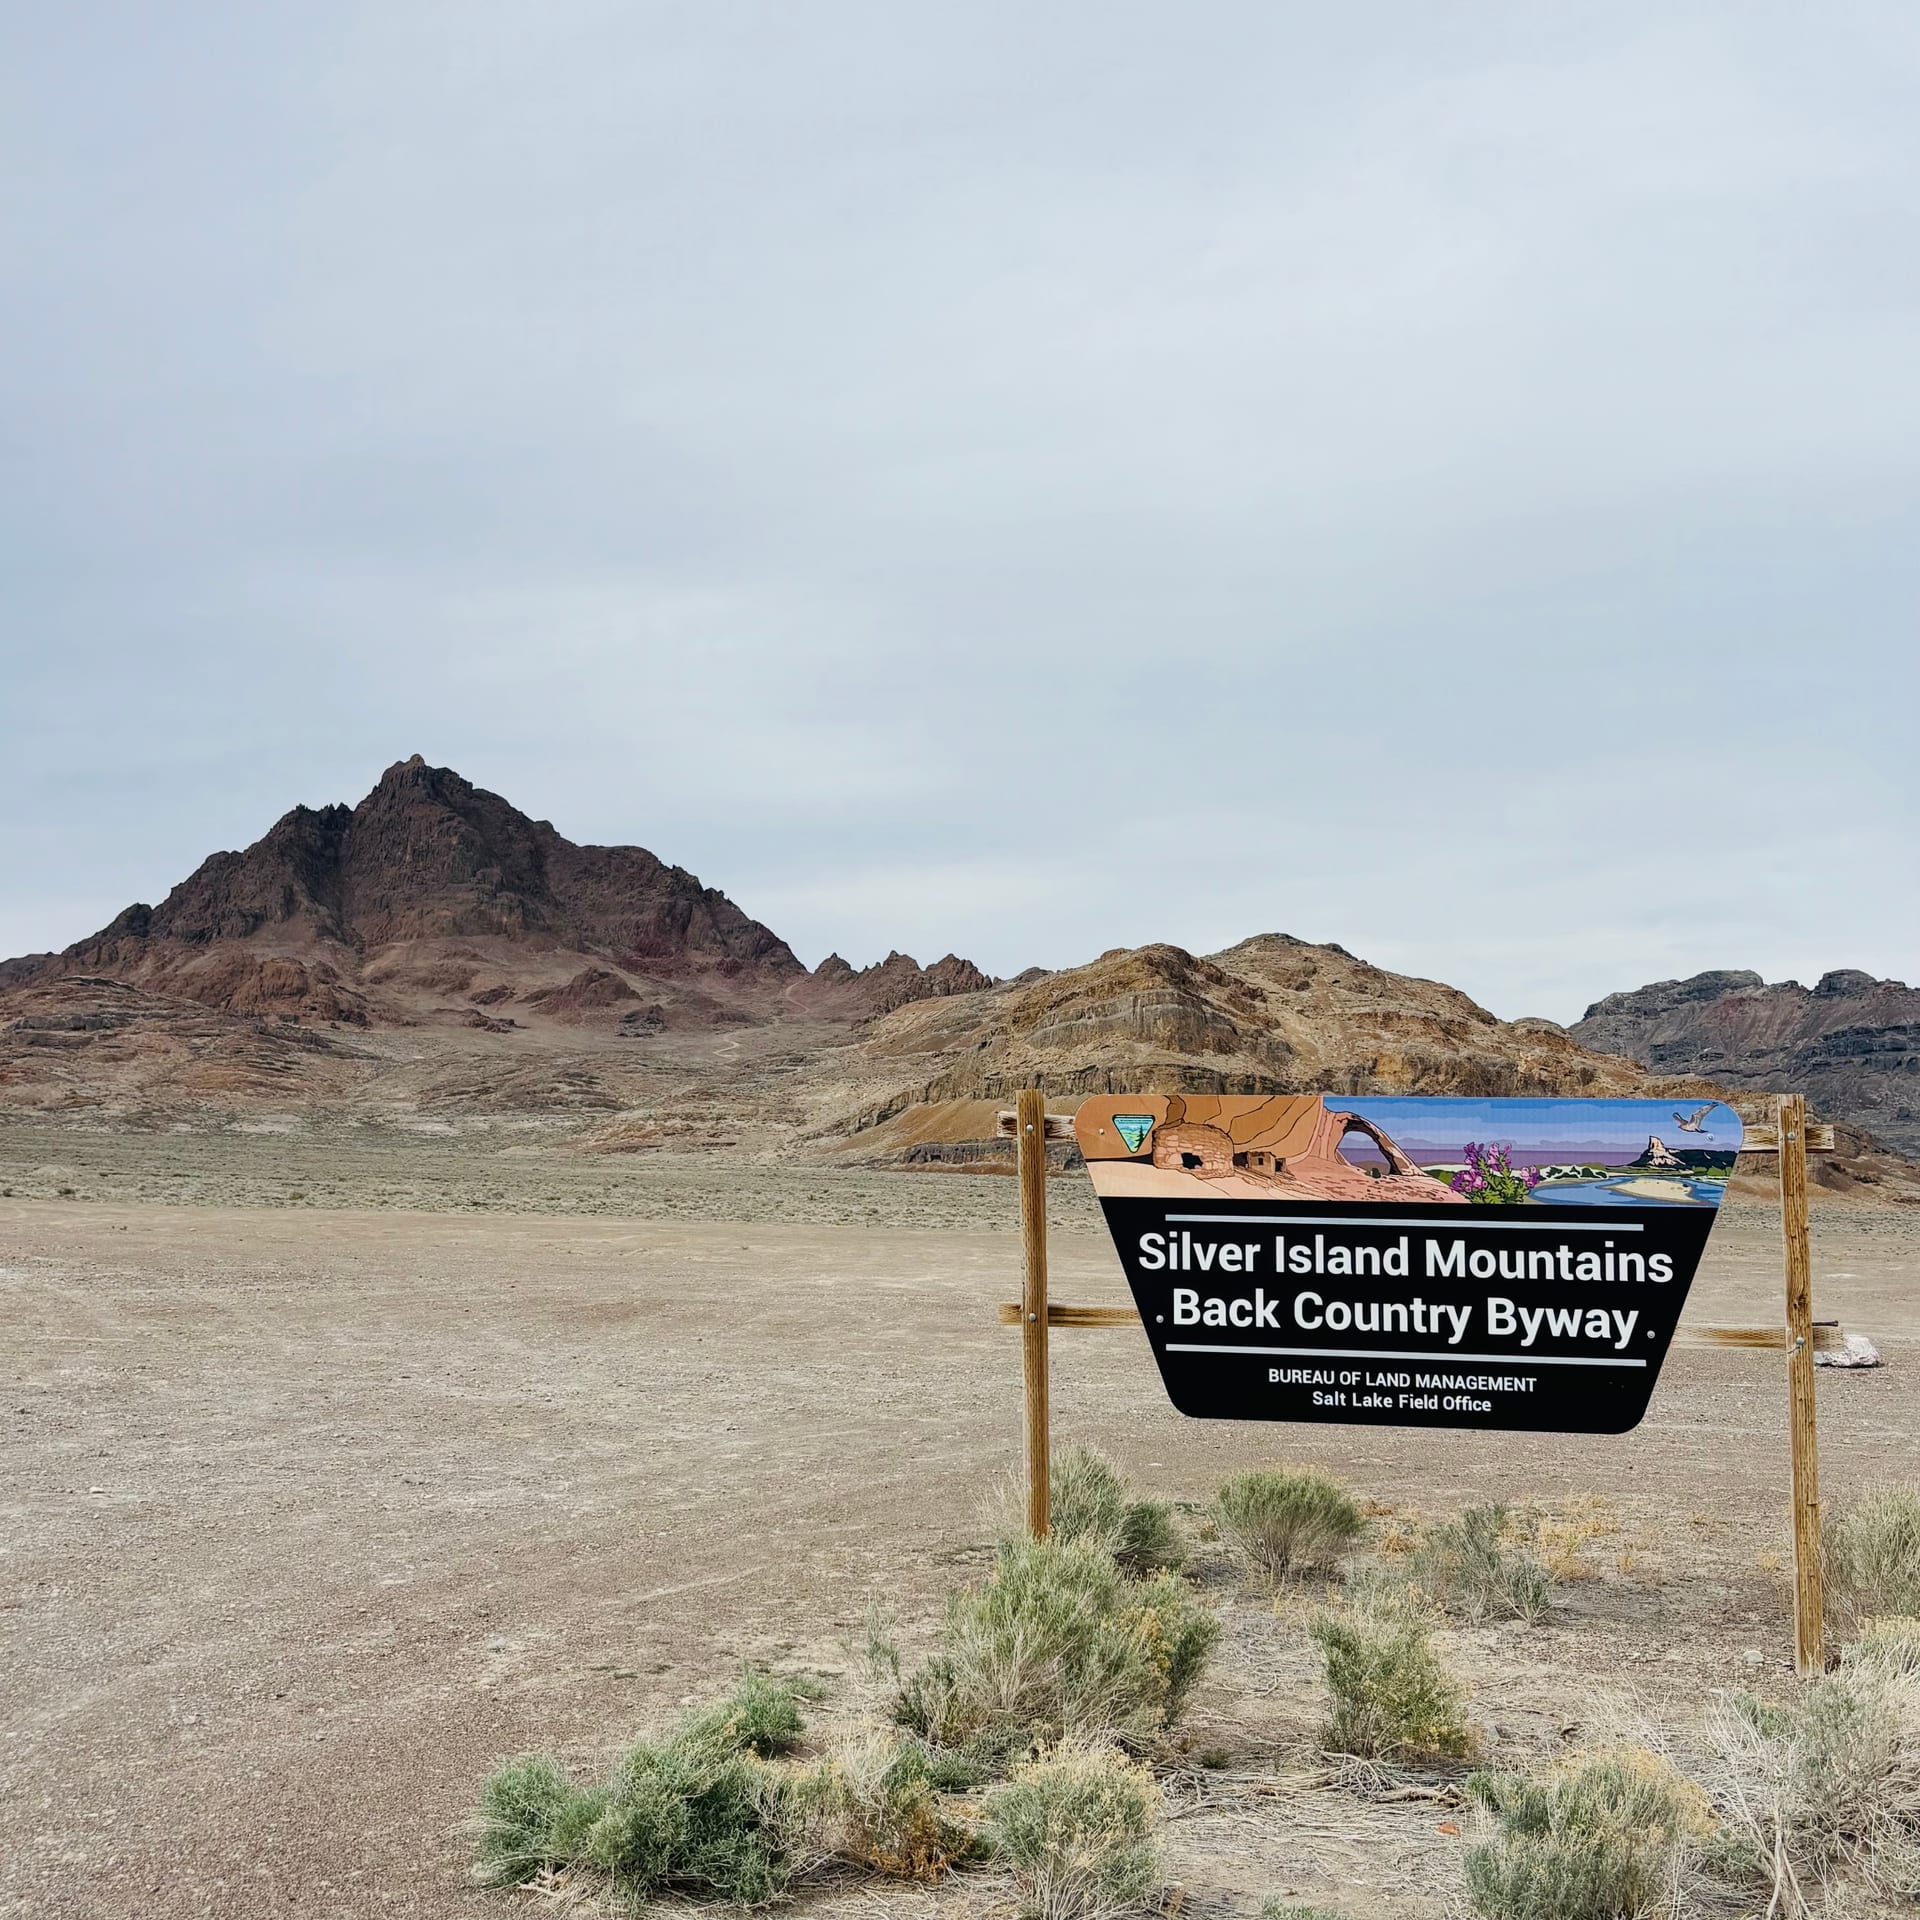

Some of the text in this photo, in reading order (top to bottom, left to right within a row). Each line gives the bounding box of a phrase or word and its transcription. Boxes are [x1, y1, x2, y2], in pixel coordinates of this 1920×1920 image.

[1139, 1231, 1673, 1282] Silver Island Mountains
[1174, 1288, 1639, 1349] Back Country Byway
[1269, 1369, 1537, 1392] BUREAU OF LAND MANAGEMENT
[1313, 1391, 1491, 1411] Salt Lake Field Office
